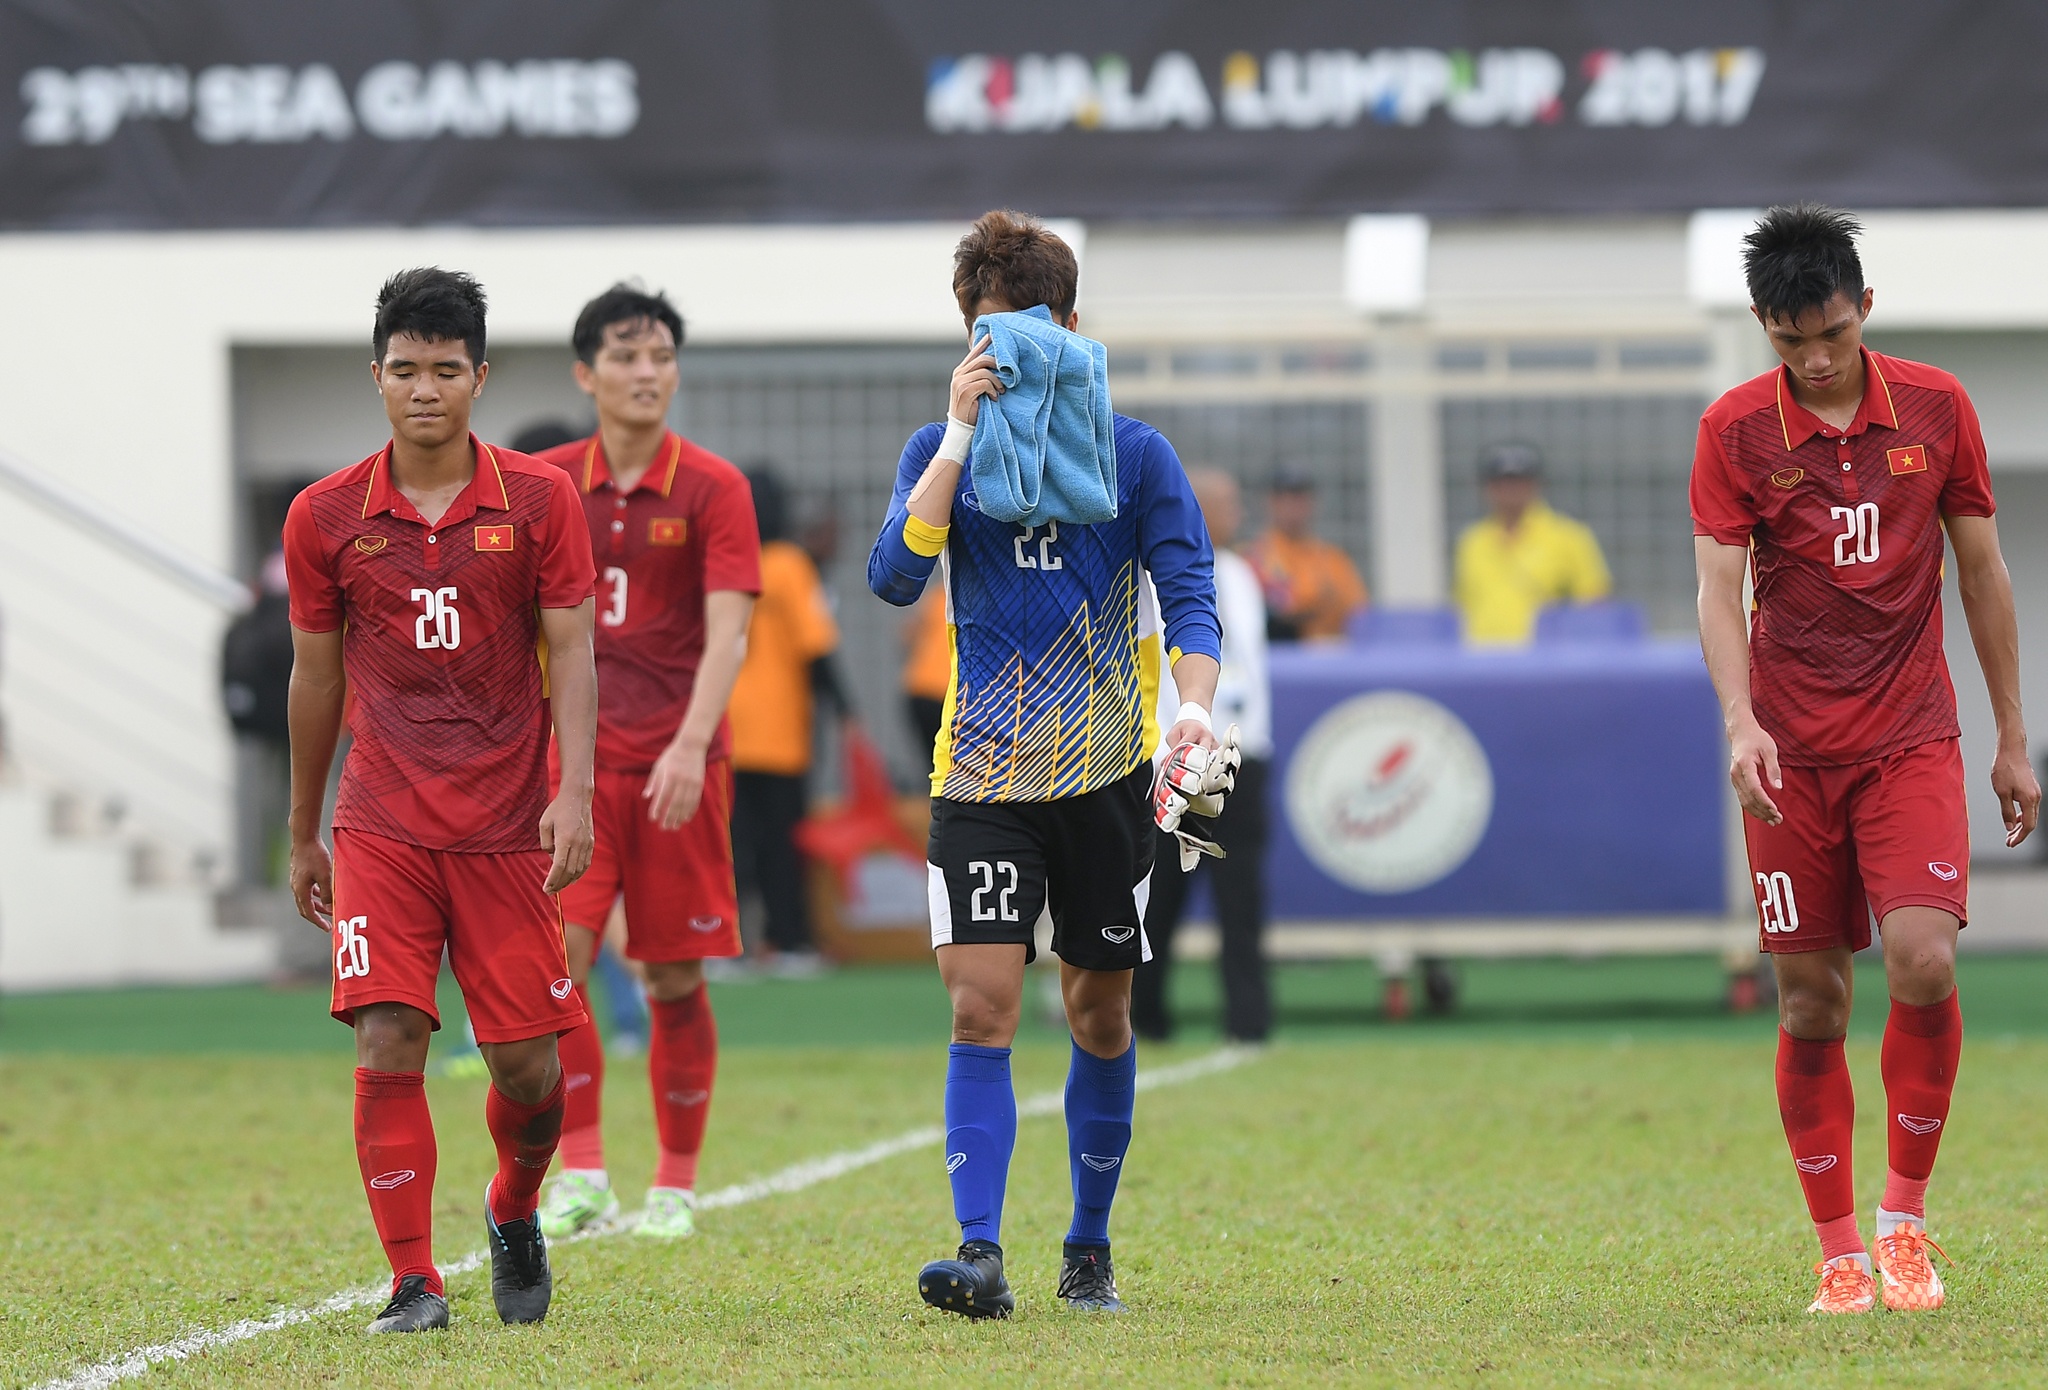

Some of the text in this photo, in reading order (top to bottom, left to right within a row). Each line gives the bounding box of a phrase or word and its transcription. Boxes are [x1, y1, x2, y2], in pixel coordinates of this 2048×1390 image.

[21, 59, 639, 144] 29TH SEA GAMES
[926, 48, 1767, 132] KUALA LUMPUR 2017
[1014, 519, 1062, 571] 22
[1830, 502, 1880, 567] 20
[410, 586, 461, 650] 26
[601, 566, 628, 627] 3
[968, 860, 1020, 922] 22
[1756, 871, 1799, 933] 20
[336, 915, 371, 980] 26
